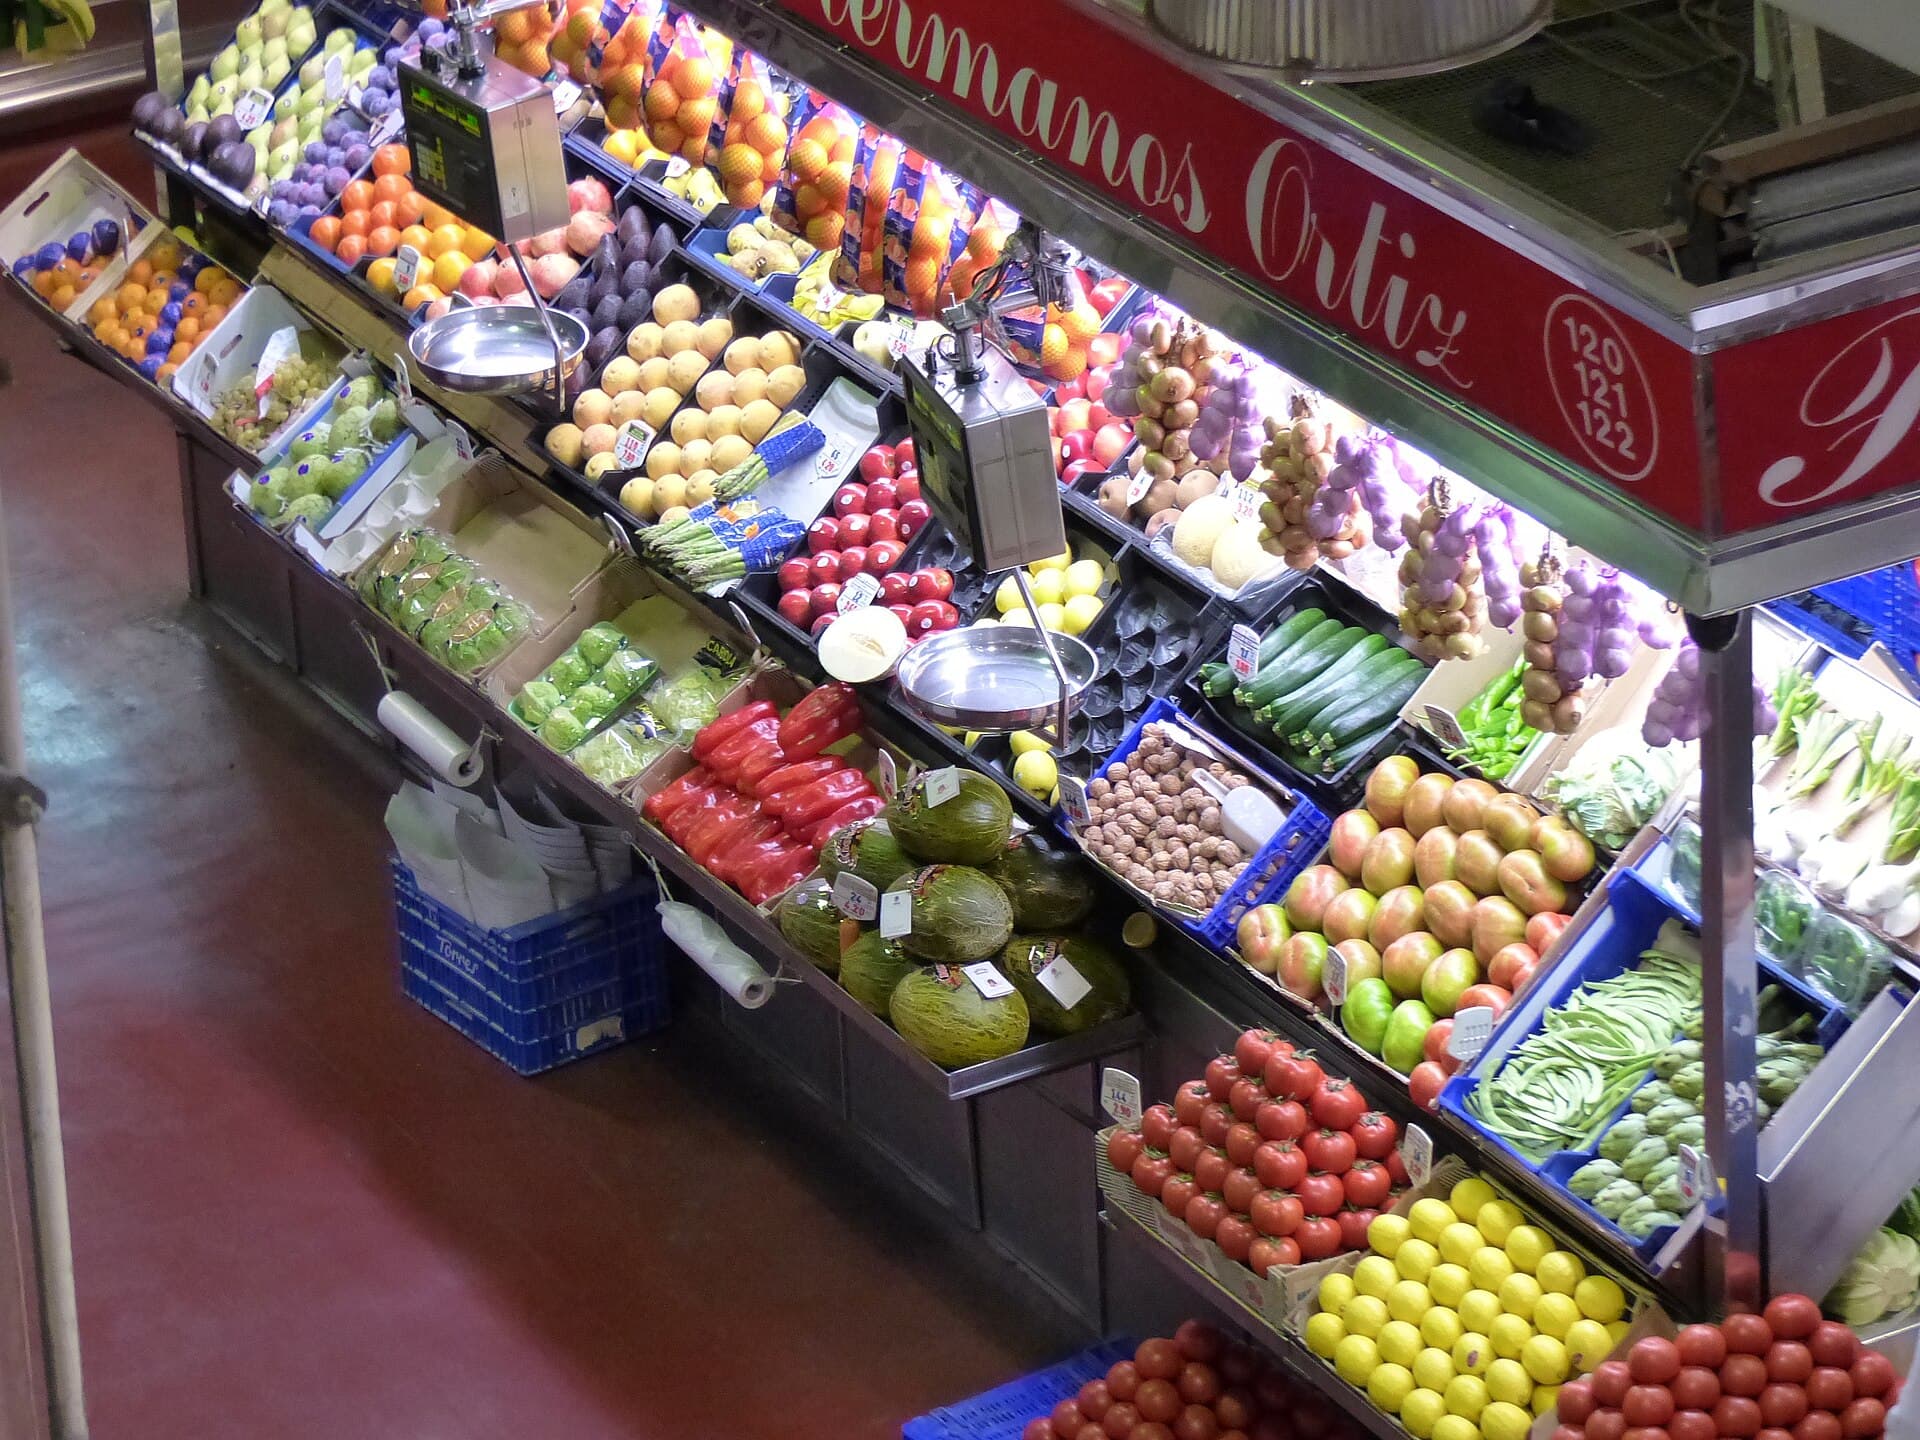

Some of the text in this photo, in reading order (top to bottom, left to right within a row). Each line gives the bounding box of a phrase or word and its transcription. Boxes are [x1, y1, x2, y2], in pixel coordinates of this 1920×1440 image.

[822, 0, 1474, 389] ermanos Ortiz
[1562, 316, 1625, 376] 120
[1573, 361, 1628, 418] 121
[1576, 401, 1637, 461] 122
[436, 934, 480, 976] Torres
